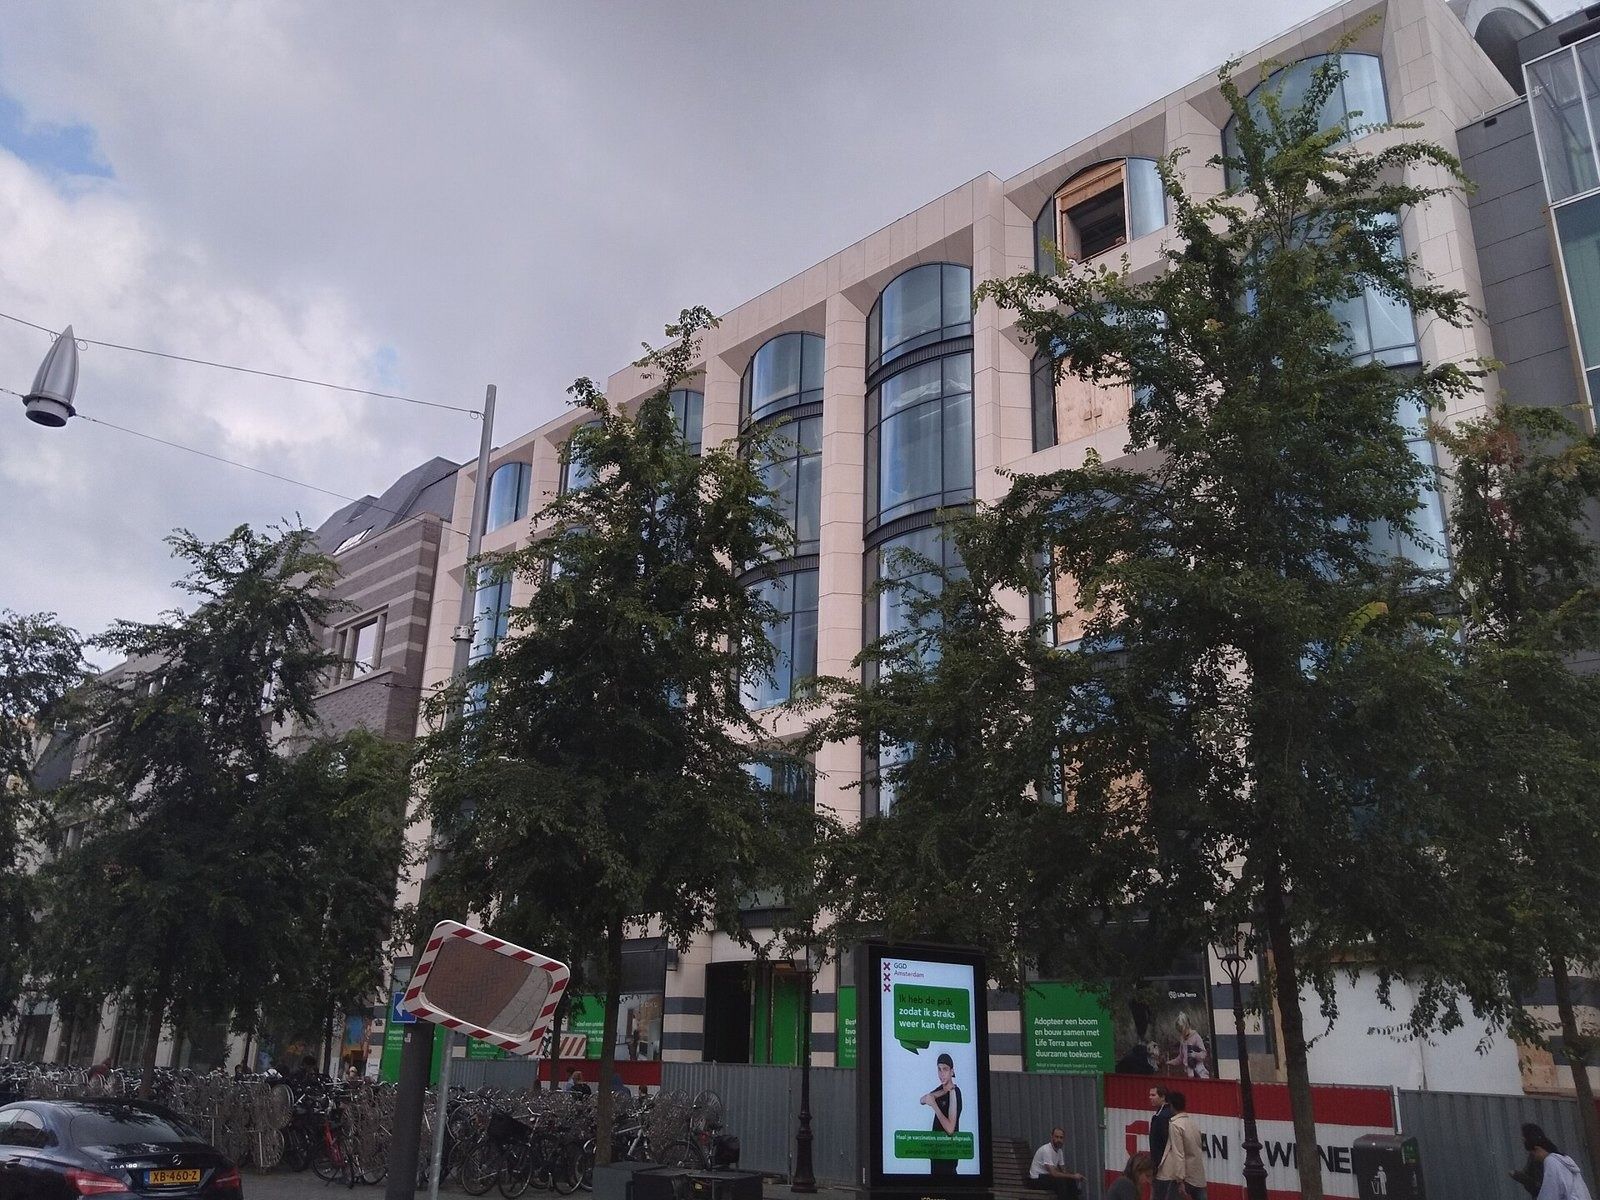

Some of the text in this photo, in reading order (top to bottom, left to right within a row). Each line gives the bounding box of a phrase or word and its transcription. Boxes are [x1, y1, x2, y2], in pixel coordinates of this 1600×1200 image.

[899, 994, 952, 1007] Ik heb de prik
[899, 1007, 956, 1018] zodat ik straks
[922, 1020, 936, 1028] kan
[938, 1021, 968, 1030] feesten.
[1034, 1018, 1064, 1026] Adopteer
[1036, 1049, 1068, 1058] duurzame
[1200, 1132, 1228, 1160] AN
[153, 1171, 197, 1182] XB-460-Z
